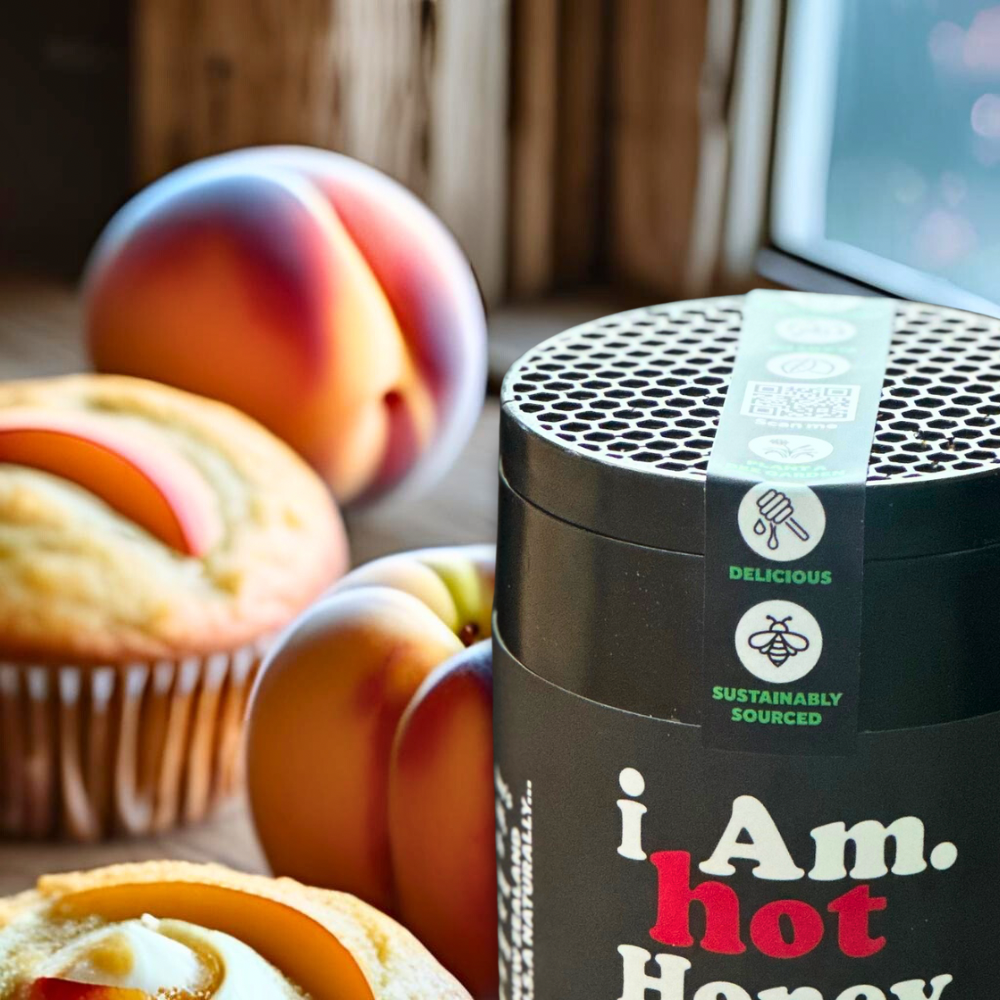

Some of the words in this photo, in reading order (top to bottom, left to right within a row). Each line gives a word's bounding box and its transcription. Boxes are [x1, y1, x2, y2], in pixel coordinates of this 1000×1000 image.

[755, 418, 803, 429] Scan
[807, 422, 838, 430] me
[729, 565, 832, 585] DELICIOUS
[712, 685, 842, 708] SUSTAINABLY
[731, 707, 822, 726] SOURCED
[616, 767, 647, 861] i
[698, 795, 958, 881] Am.
[649, 849, 887, 959] hot
